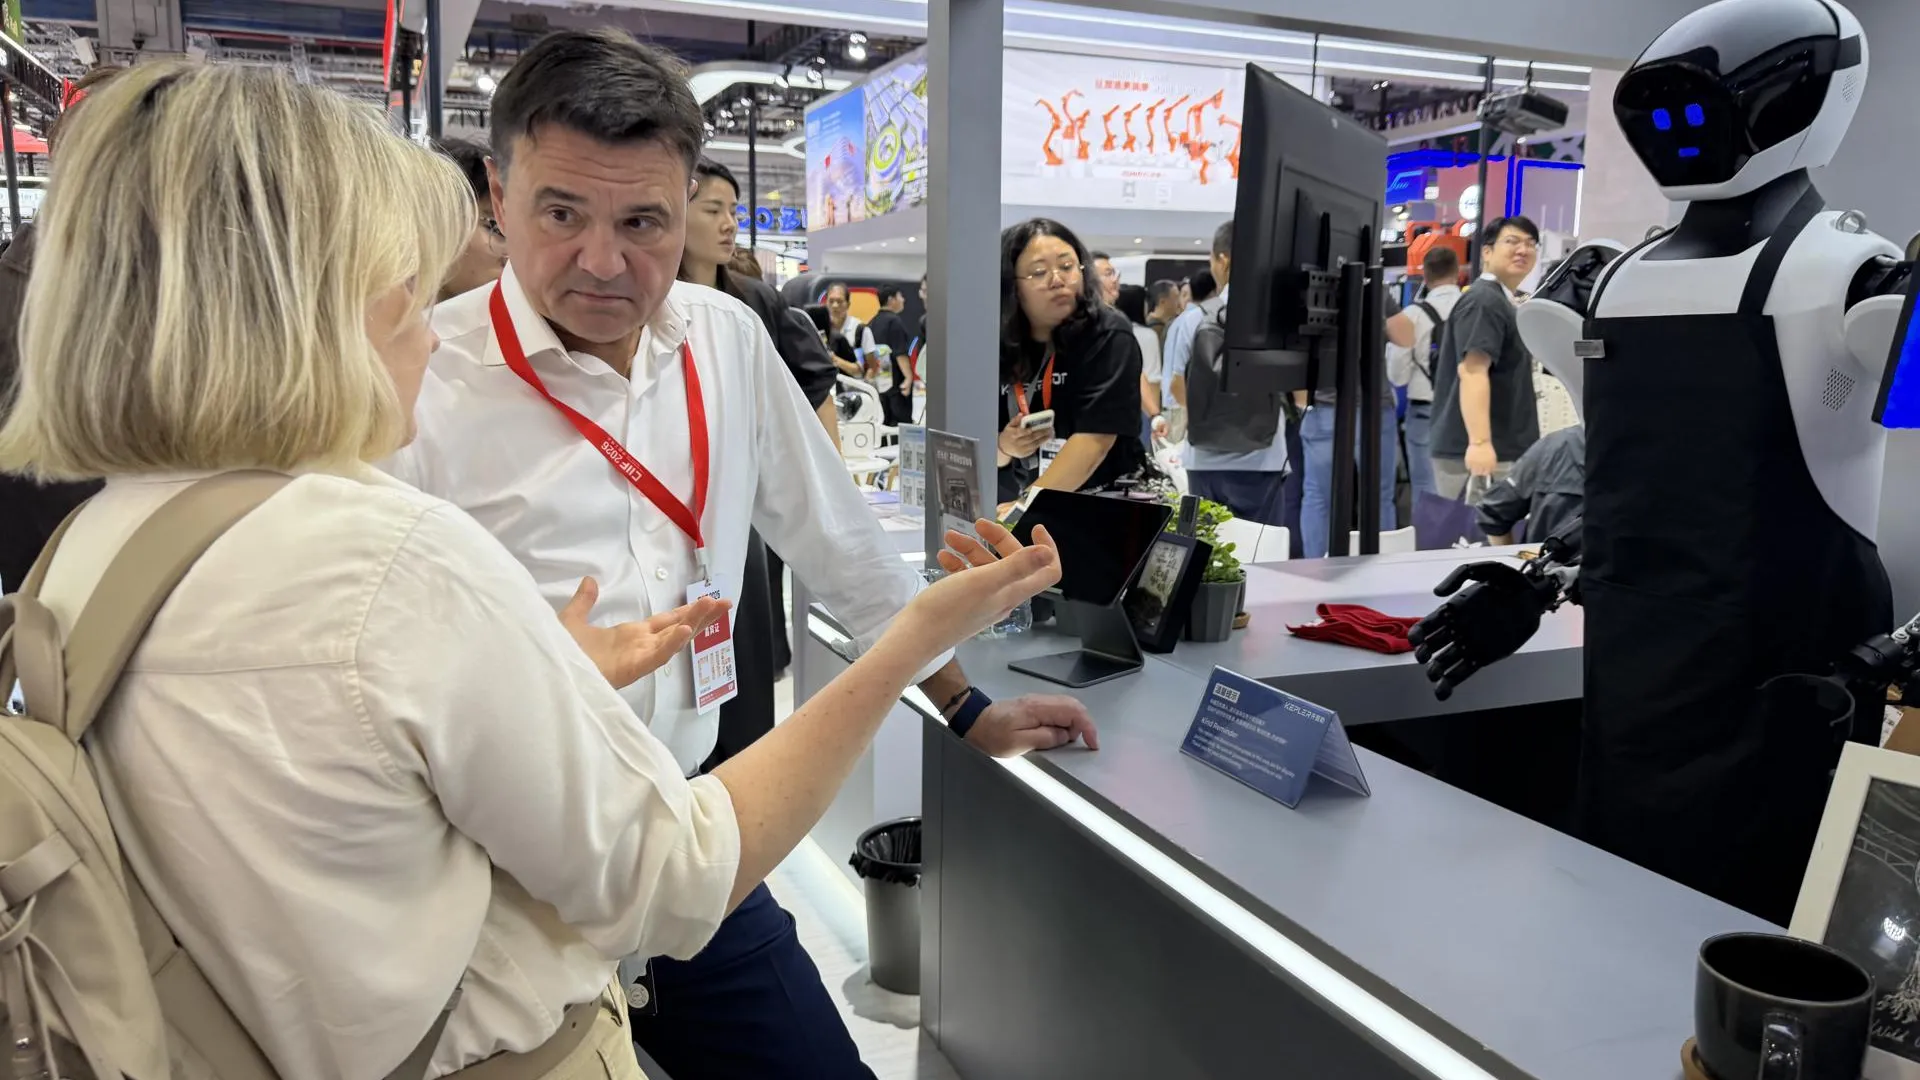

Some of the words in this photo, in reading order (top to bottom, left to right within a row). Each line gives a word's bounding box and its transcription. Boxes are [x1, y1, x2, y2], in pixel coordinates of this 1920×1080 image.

[601, 441, 623, 463] 2026
[619, 461, 643, 482] CIIF
[1284, 702, 1312, 718] KEPLER
[1201, 716, 1214, 728] Kind
[1212, 722, 1239, 738] Reminder
